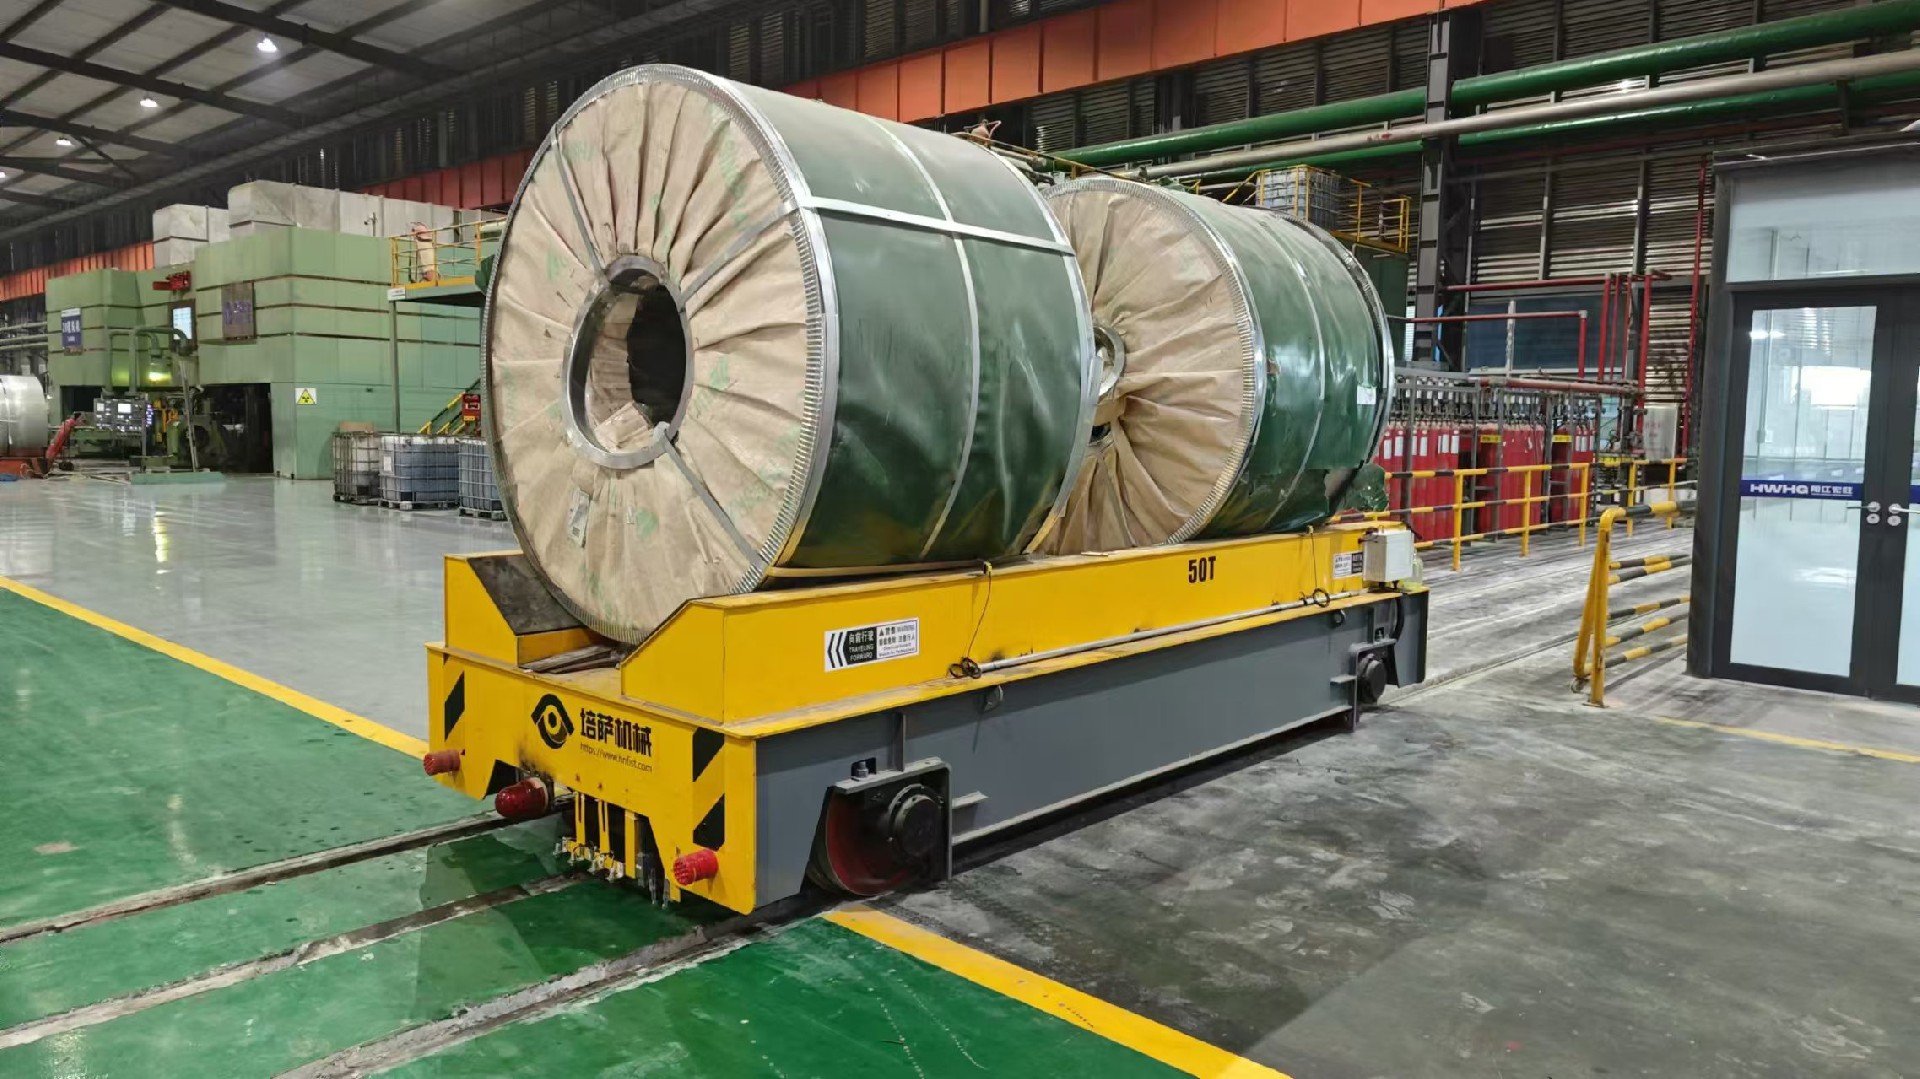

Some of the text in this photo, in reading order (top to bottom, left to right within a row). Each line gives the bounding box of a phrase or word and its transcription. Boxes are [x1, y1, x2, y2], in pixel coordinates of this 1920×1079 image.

[1750, 483, 1809, 495] HWHG
[1188, 555, 1217, 583] 50T
[580, 707, 652, 757] 培萨机械
